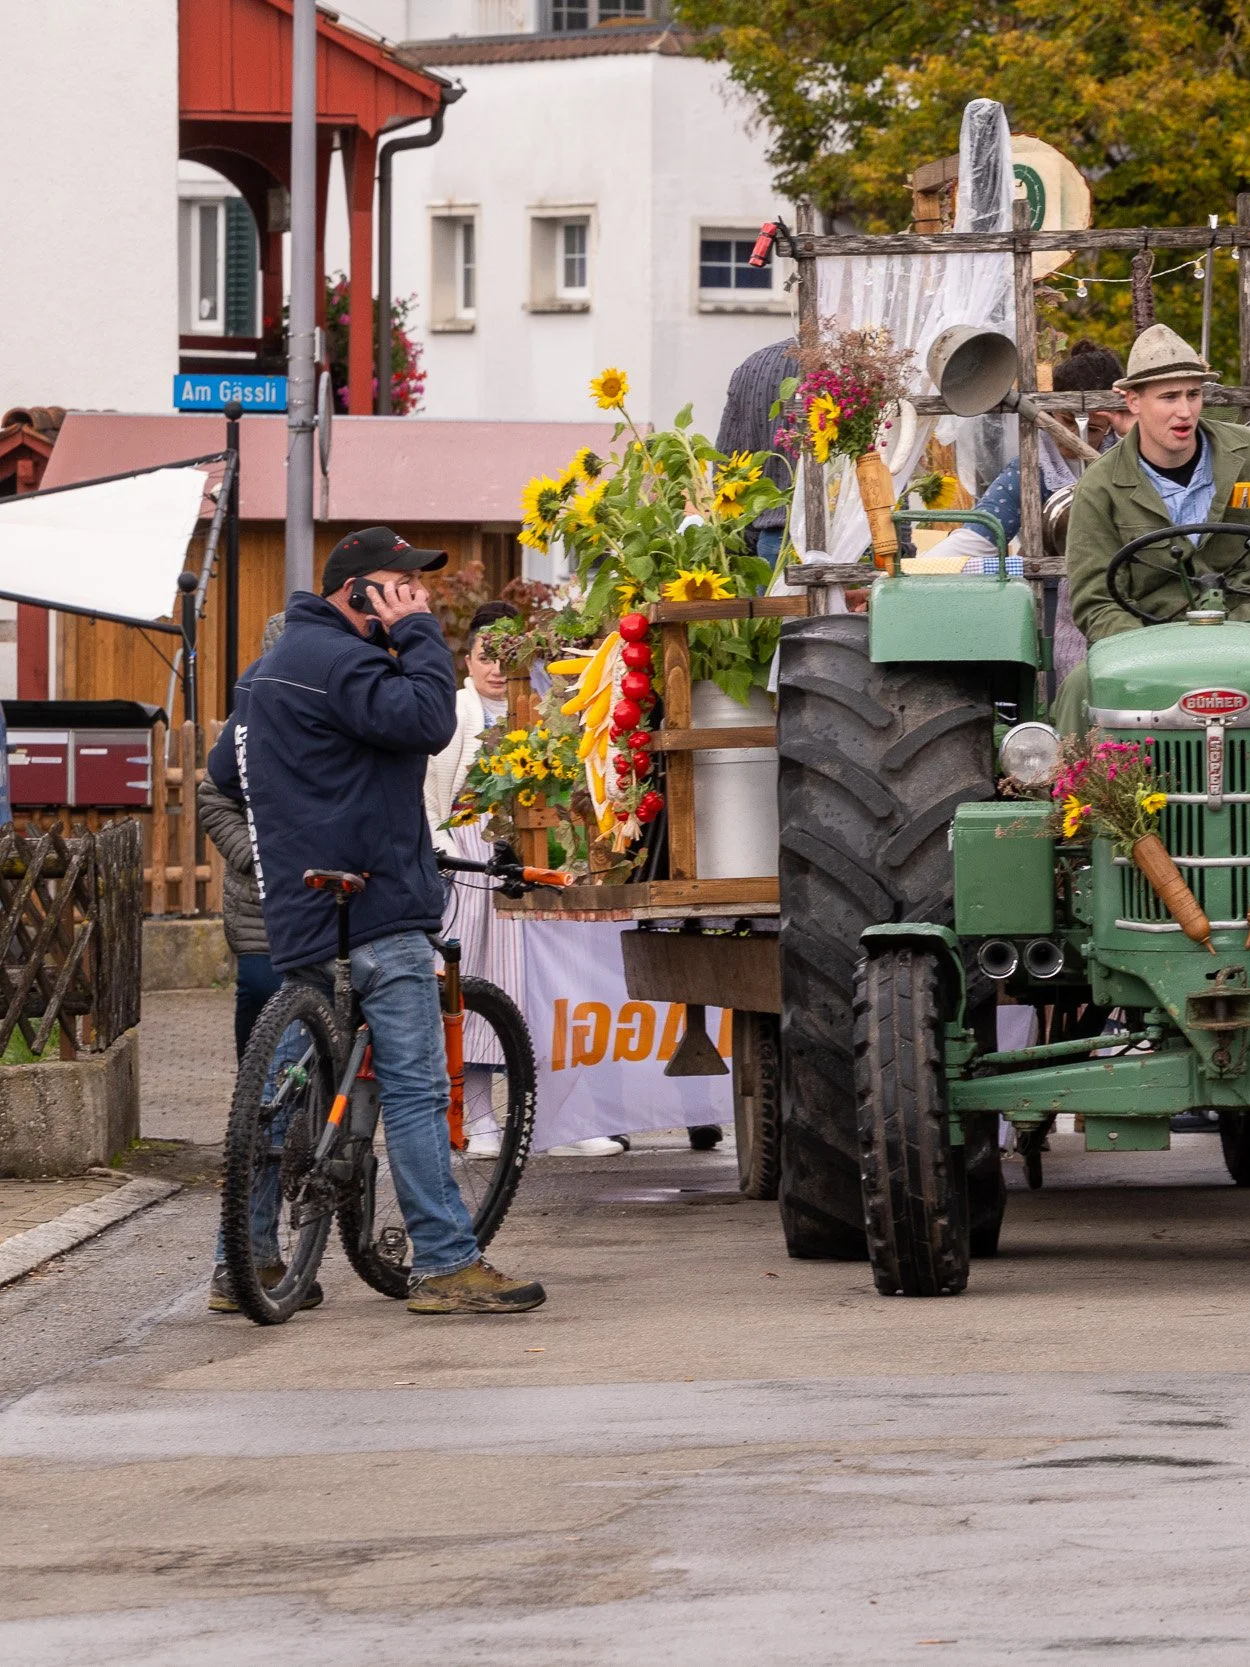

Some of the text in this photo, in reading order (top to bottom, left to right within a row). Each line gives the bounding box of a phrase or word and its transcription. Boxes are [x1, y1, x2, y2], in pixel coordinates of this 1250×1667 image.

[181, 380, 277, 403] Am Gässli
[1186, 696, 1243, 709] BÜHRER
[515, 1091, 533, 1168] MAXXIS
